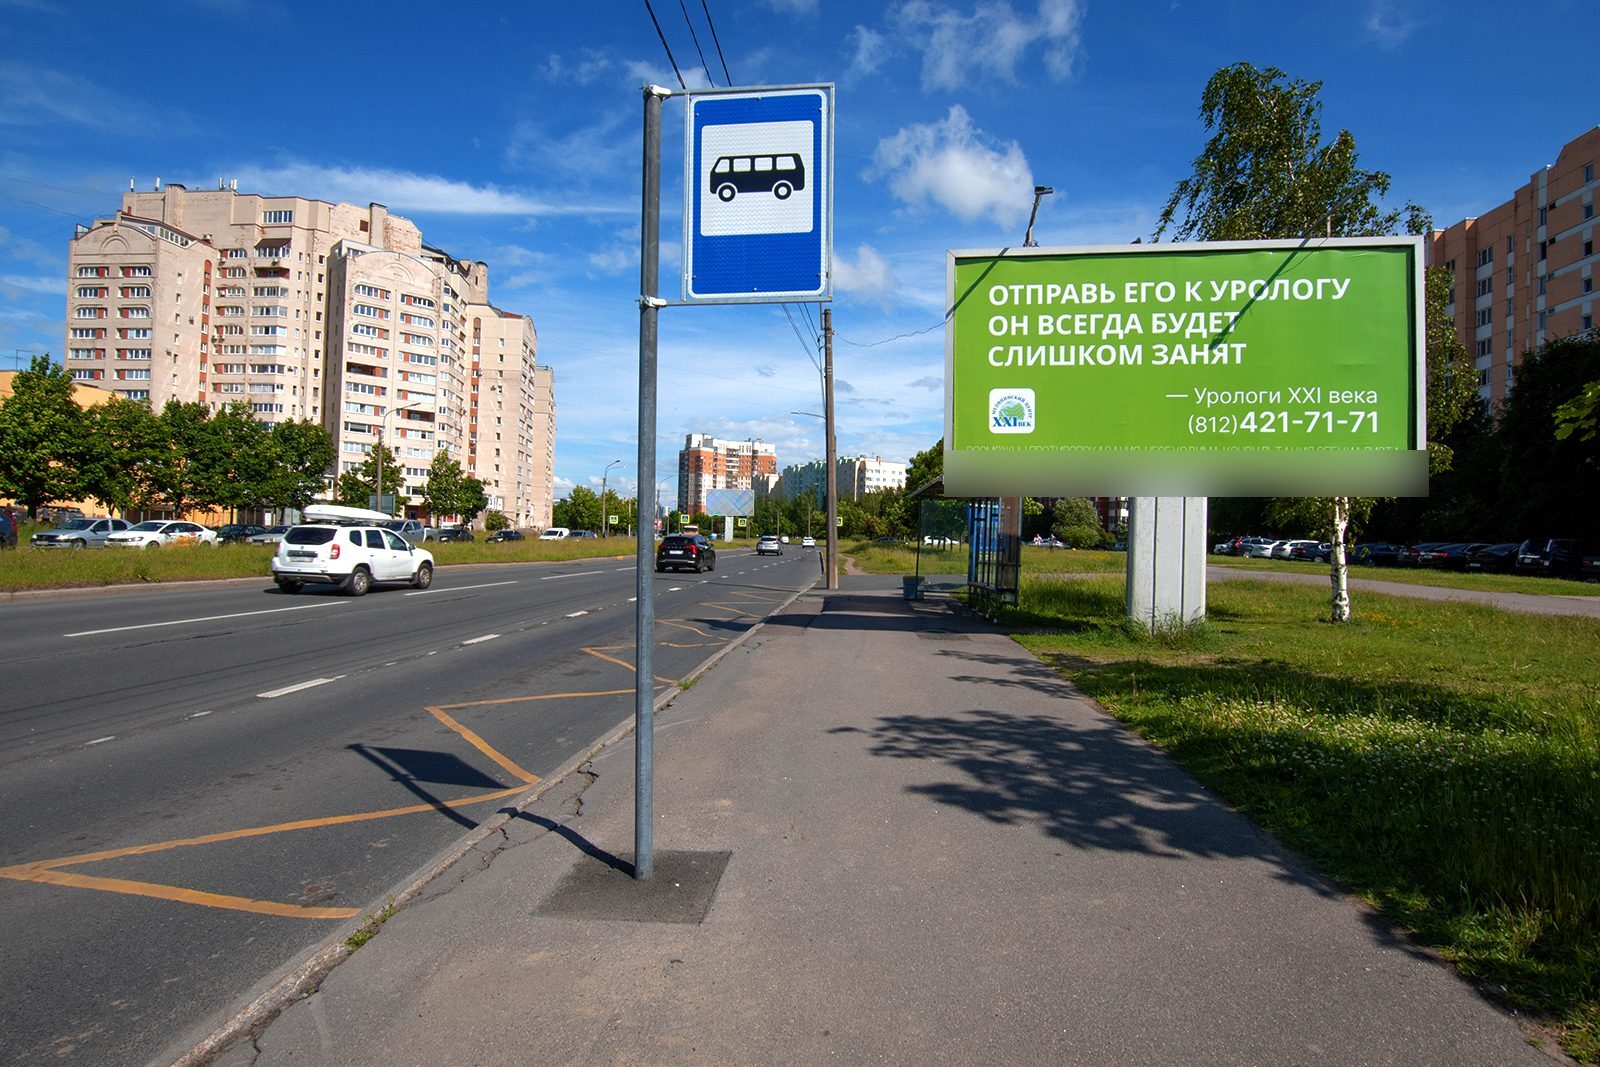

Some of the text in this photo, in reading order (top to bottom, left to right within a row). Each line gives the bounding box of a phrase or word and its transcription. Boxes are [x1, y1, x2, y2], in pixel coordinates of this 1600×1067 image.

[988, 277, 1352, 306] ОТПРАВЬ ЕГО К УРОЛОГУ
[988, 310, 1241, 341] ОН ВСЕГДА БУДЕТ
[987, 342, 1248, 367] СЛИШКОМ ЗАНЯТ
[1193, 387, 1281, 409] Урологи
[1287, 386, 1322, 404] XXI
[1328, 390, 1379, 404] века
